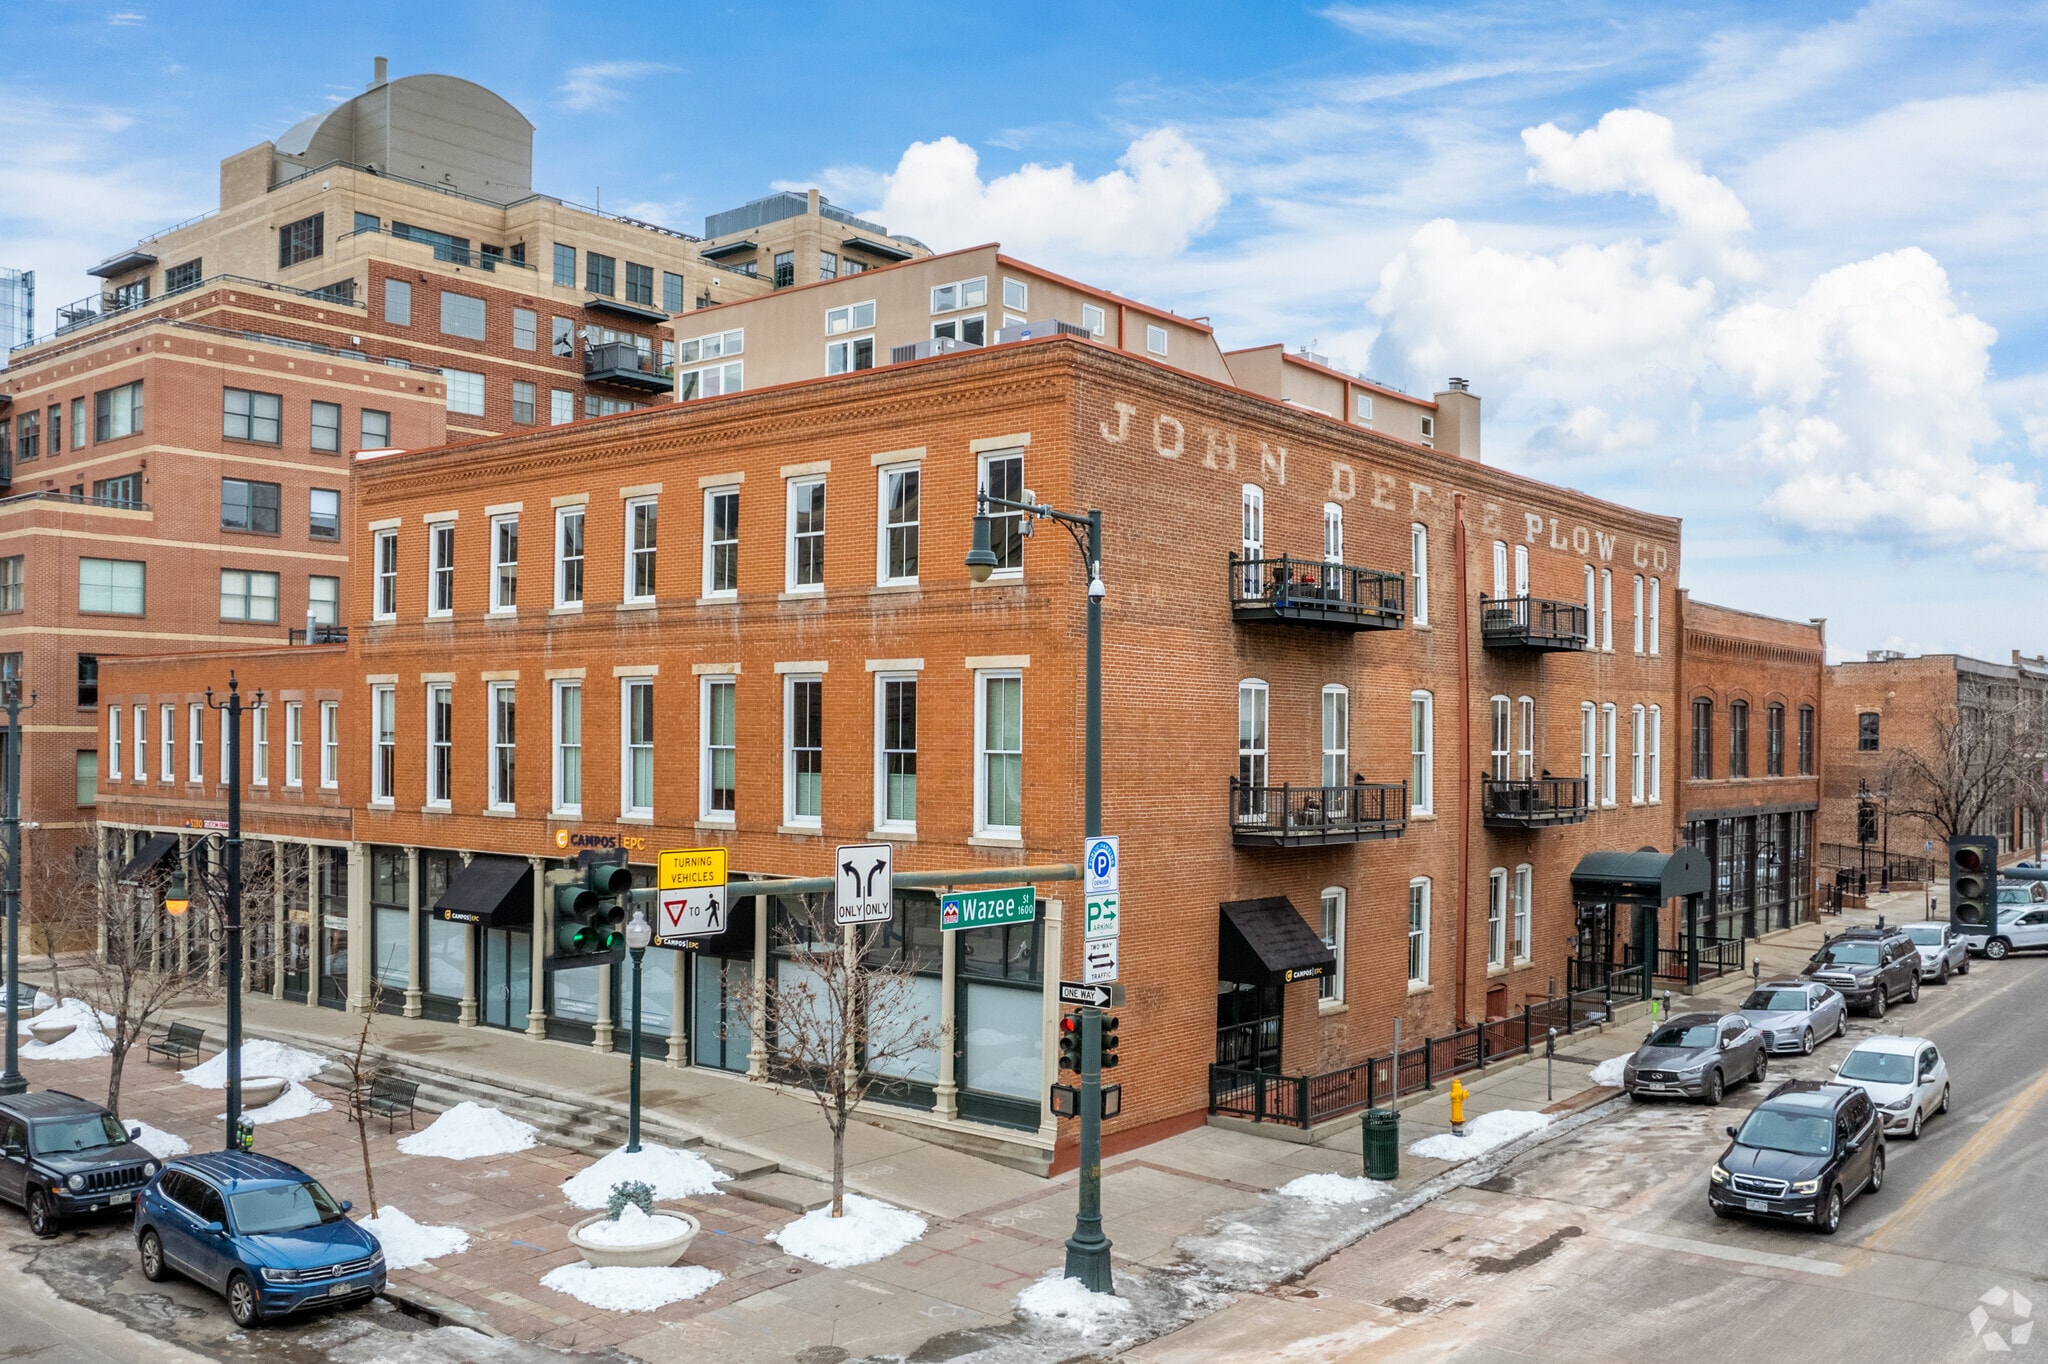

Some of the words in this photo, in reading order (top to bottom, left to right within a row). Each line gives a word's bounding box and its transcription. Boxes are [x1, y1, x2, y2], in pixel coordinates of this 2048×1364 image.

[1100, 402, 1288, 485] JOHN
[1524, 512, 1616, 561] PLOW
[571, 833, 615, 848] CAMPOS
[623, 837, 645, 850] EPC
[673, 856, 712, 868] TURNING
[671, 871, 714, 883] VEHICLES
[689, 906, 701, 917] TO
[839, 905, 863, 918] ONLY
[865, 902, 889, 916] ONLY
[962, 898, 1015, 922] Wazee
[1022, 893, 1030, 904] St
[1017, 904, 1034, 915] 1600
[664, 938, 686, 947] CAMPOS
[689, 941, 699, 949] EPC
[1090, 943, 1100, 951] TWO
[1102, 942, 1113, 950] WAY
[1091, 971, 1111, 980] TRAFFIC
[1293, 969, 1312, 978] CAMPOS
[1064, 988, 1079, 998] ONE
[1080, 990, 1096, 1000] WAY
